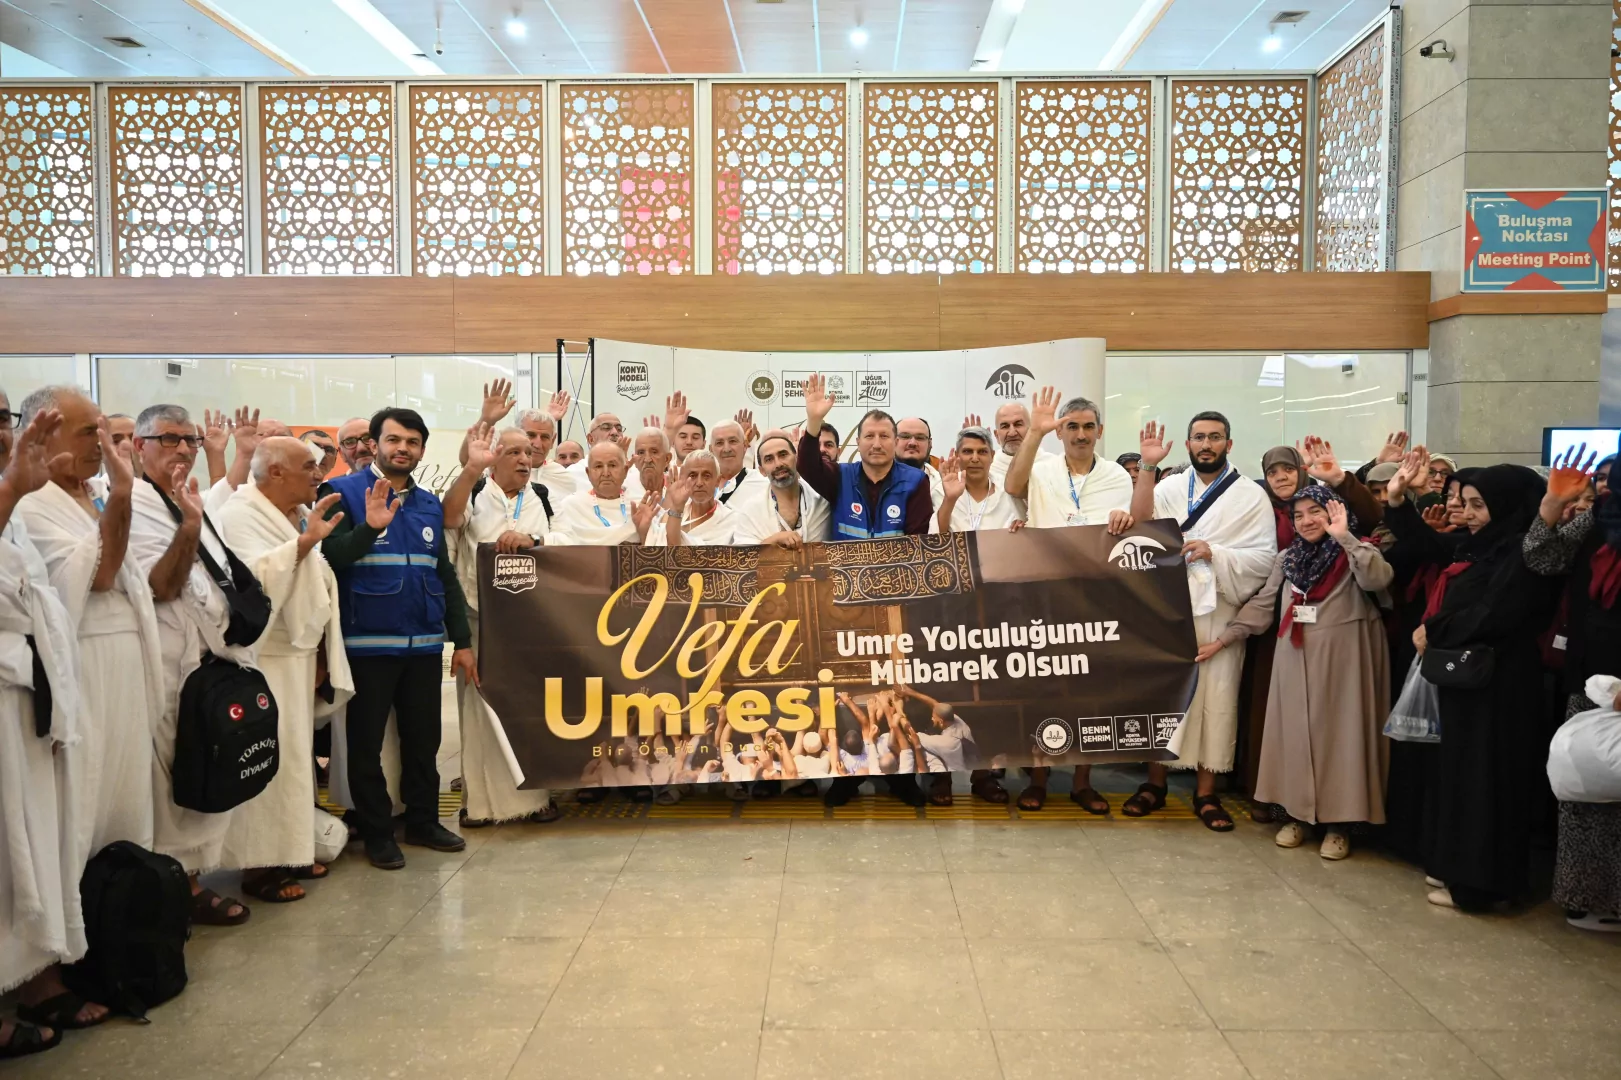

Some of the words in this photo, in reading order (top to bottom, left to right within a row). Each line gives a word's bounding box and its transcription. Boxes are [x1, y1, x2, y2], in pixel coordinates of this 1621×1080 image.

[1498, 214, 1573, 230] Buluşma
[1502, 229, 1568, 242] Noktası
[1478, 253, 1543, 268] Meeting
[1549, 252, 1590, 265] Point
[620, 366, 646, 374] KONYA
[784, 380, 810, 388] BEN
[994, 371, 1024, 396] aile
[858, 386, 888, 402] Altay
[498, 558, 533, 567] KONYA
[1118, 544, 1154, 568] aile
[497, 566, 533, 575] MODELİ
[492, 574, 538, 588] Belediyecilik
[596, 572, 803, 714] Vefa
[836, 630, 914, 656] Umre
[920, 618, 1120, 652] Yolculuğunuz
[870, 654, 999, 686] Mübarek
[1006, 652, 1090, 678] Olsun
[544, 668, 836, 740] Umresi
[1082, 725, 1111, 734] BENİM
[1082, 734, 1112, 744] ŞEHRİM
[592, 746, 624, 757] Bir
[240, 756, 274, 779] DİYANET
